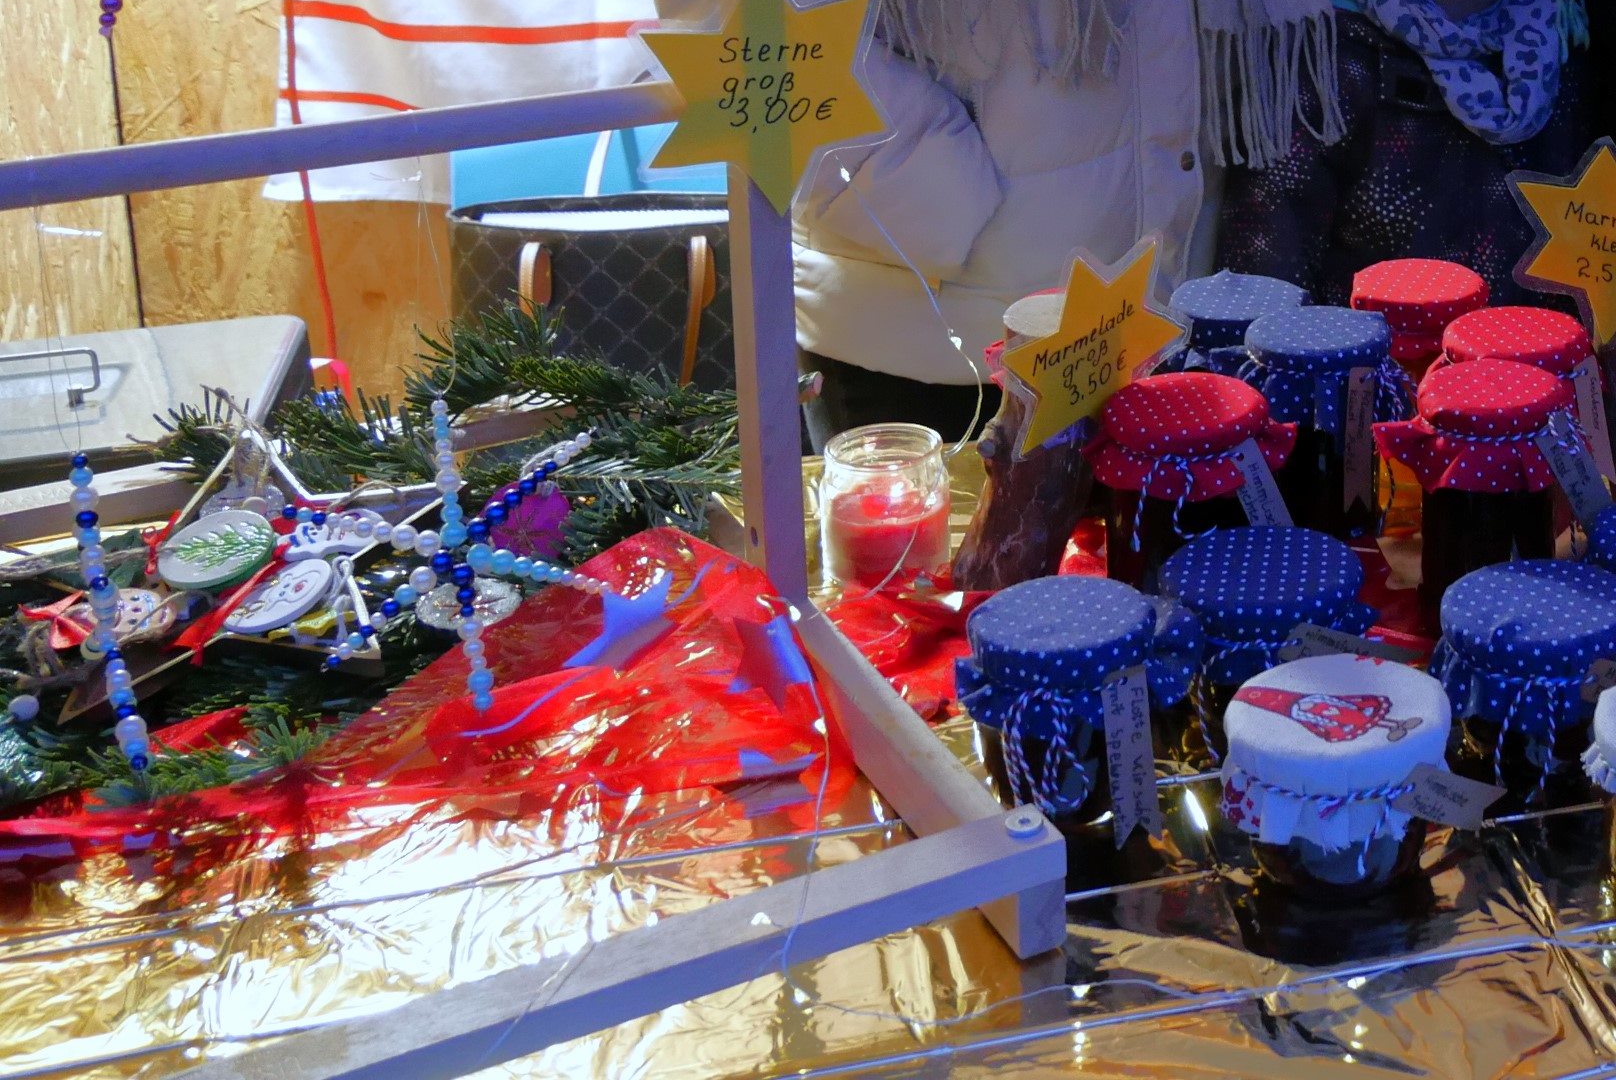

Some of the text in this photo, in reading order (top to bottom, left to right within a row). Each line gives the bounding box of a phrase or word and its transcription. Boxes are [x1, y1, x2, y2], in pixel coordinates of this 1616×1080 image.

[719, 37, 824, 63] Sterne
[719, 72, 795, 109] groß
[1032, 299, 1135, 377] Marmelade
[1062, 340, 1108, 388] groß
